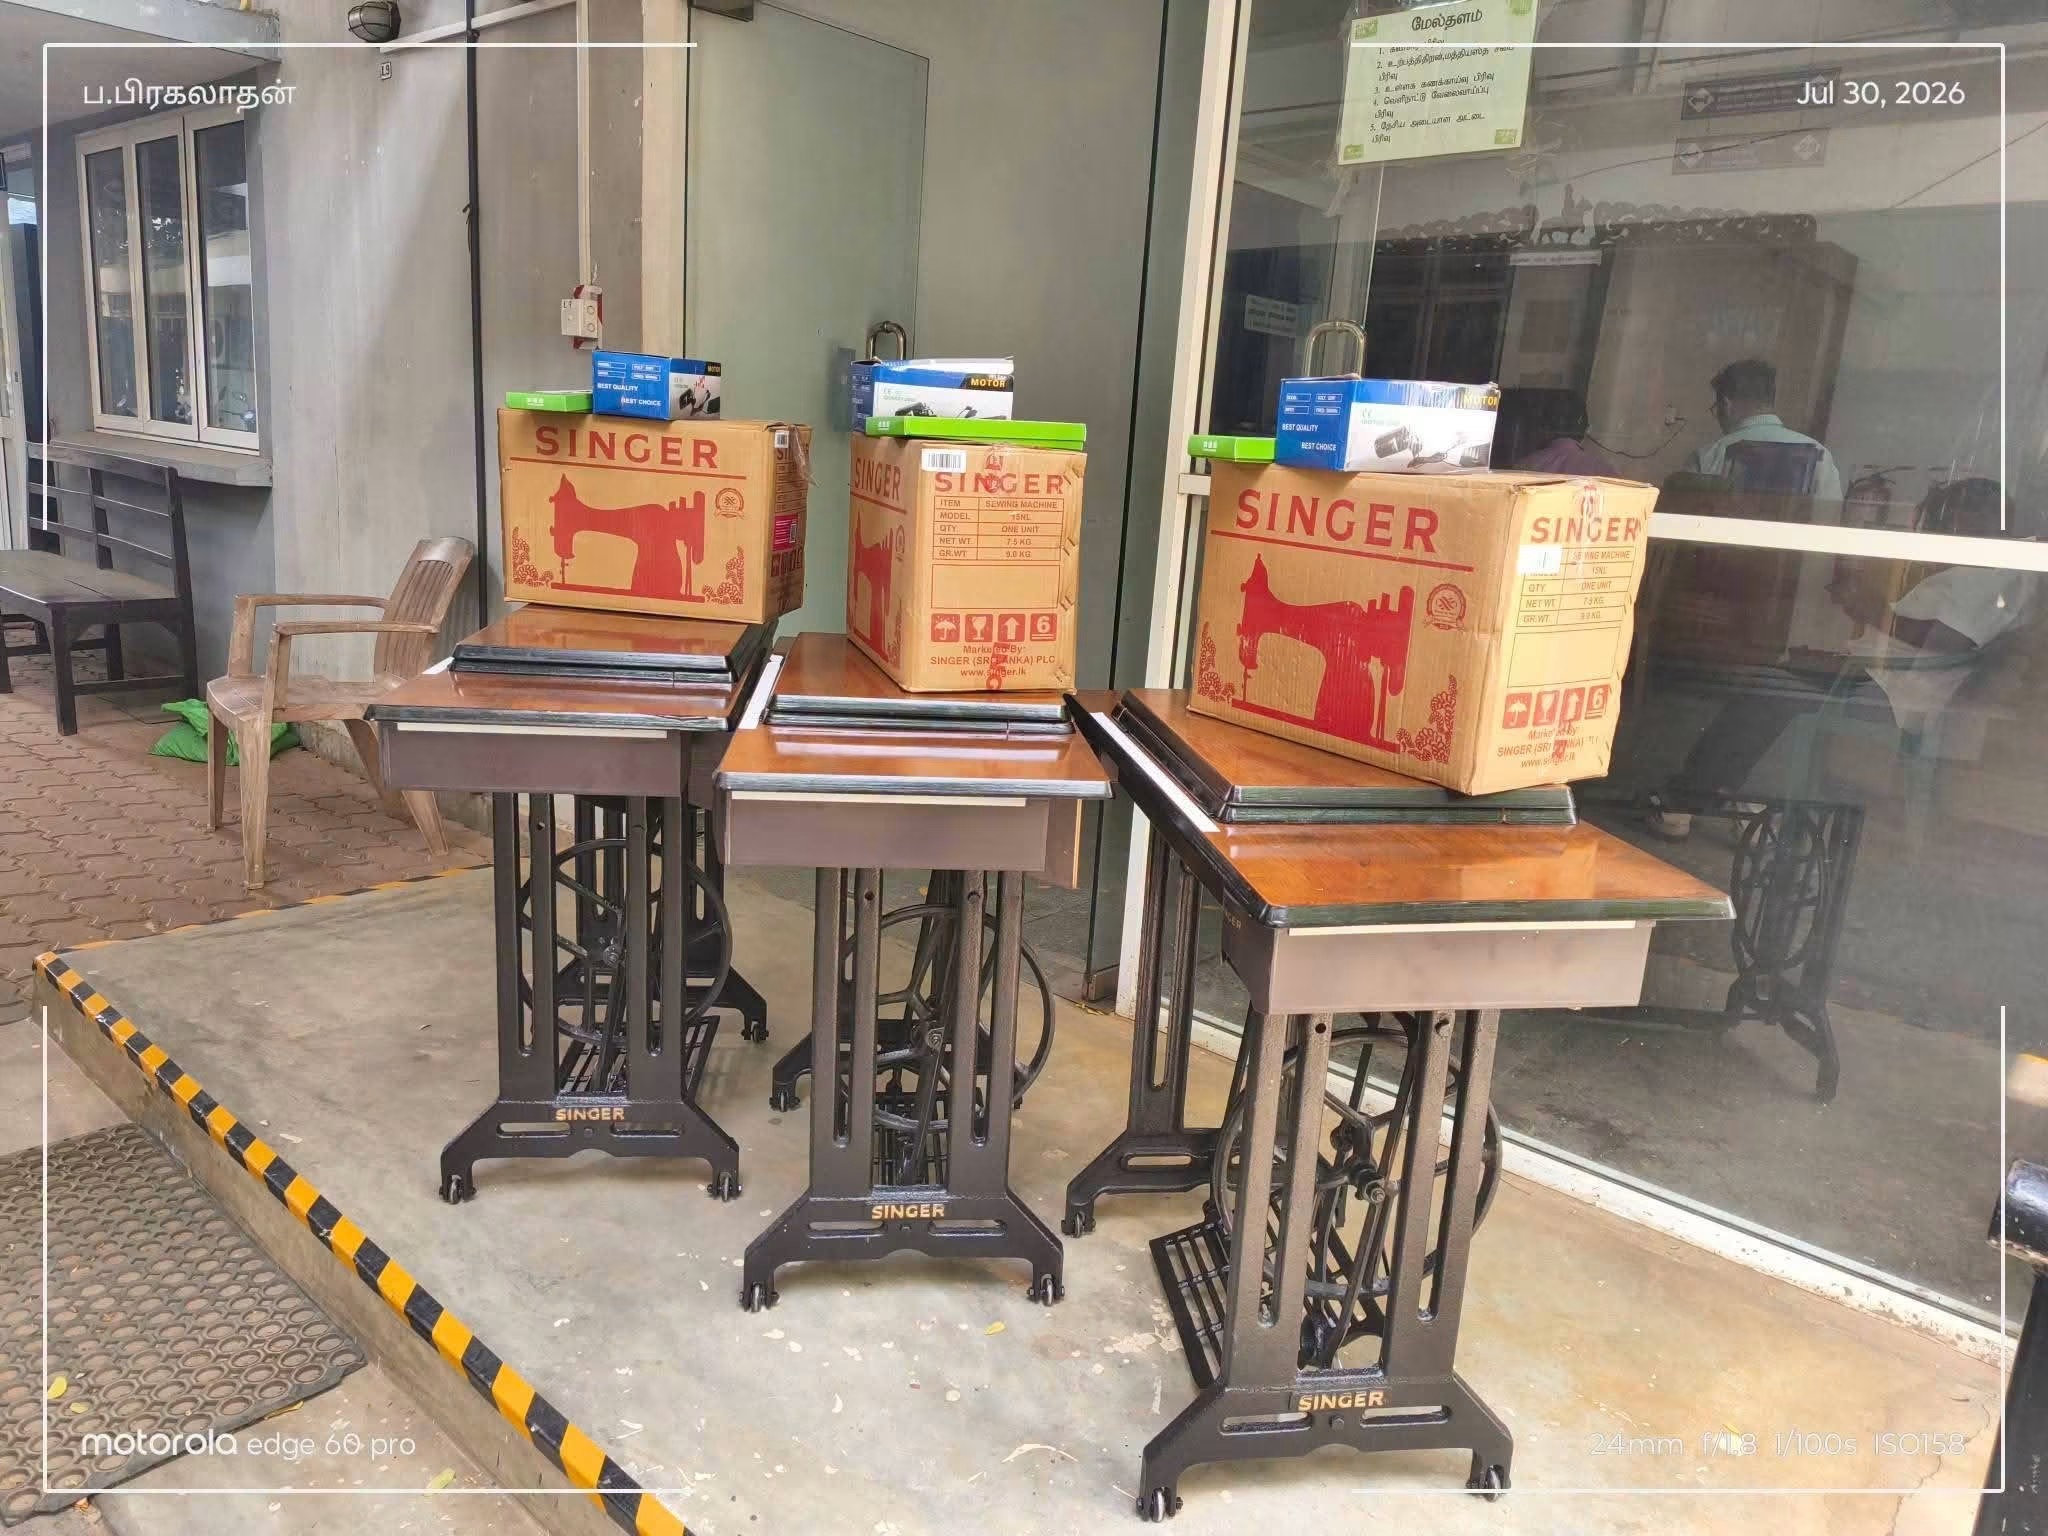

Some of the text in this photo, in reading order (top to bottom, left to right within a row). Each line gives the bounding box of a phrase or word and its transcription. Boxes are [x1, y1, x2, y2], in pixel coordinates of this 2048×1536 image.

[1411, 9, 1483, 31] மேல்தளம்
[1378, 72, 1398, 82] பிரிவு
[1473, 72, 1495, 82] பிரிவு
[1374, 109, 1394, 119] பிரிவு
[1372, 135, 1391, 145] பிரிவு
[597, 382, 639, 392] BEST QUALITY
[970, 378, 1006, 388] MOTOR
[638, 399, 662, 407] CHOICE
[1281, 423, 1319, 432] BEST QUALITY
[535, 425, 719, 469] SINGER
[1301, 441, 1337, 451] BEST CHOICE
[854, 457, 901, 501] SINGER
[934, 471, 1064, 494] SINGER
[985, 501, 1058, 509] SEWING MACHINE
[940, 511, 971, 520] MODEL
[1235, 488, 1439, 553] SINGER
[1001, 525, 1040, 534] ONE UNIT
[1530, 515, 1640, 544] SINGER
[939, 537, 956, 545] NET
[1600, 550, 1631, 559] MACHINE
[1581, 582, 1597, 591] ONE
[1525, 600, 1543, 608] NET
[1036, 615, 1051, 633] 6
[930, 656, 970, 665] SINGER
[1497, 744, 1534, 757] SINGER
[555, 1107, 625, 1121] SINGER
[871, 1203, 945, 1219] SINGER
[1298, 1390, 1385, 1412] SINGER
